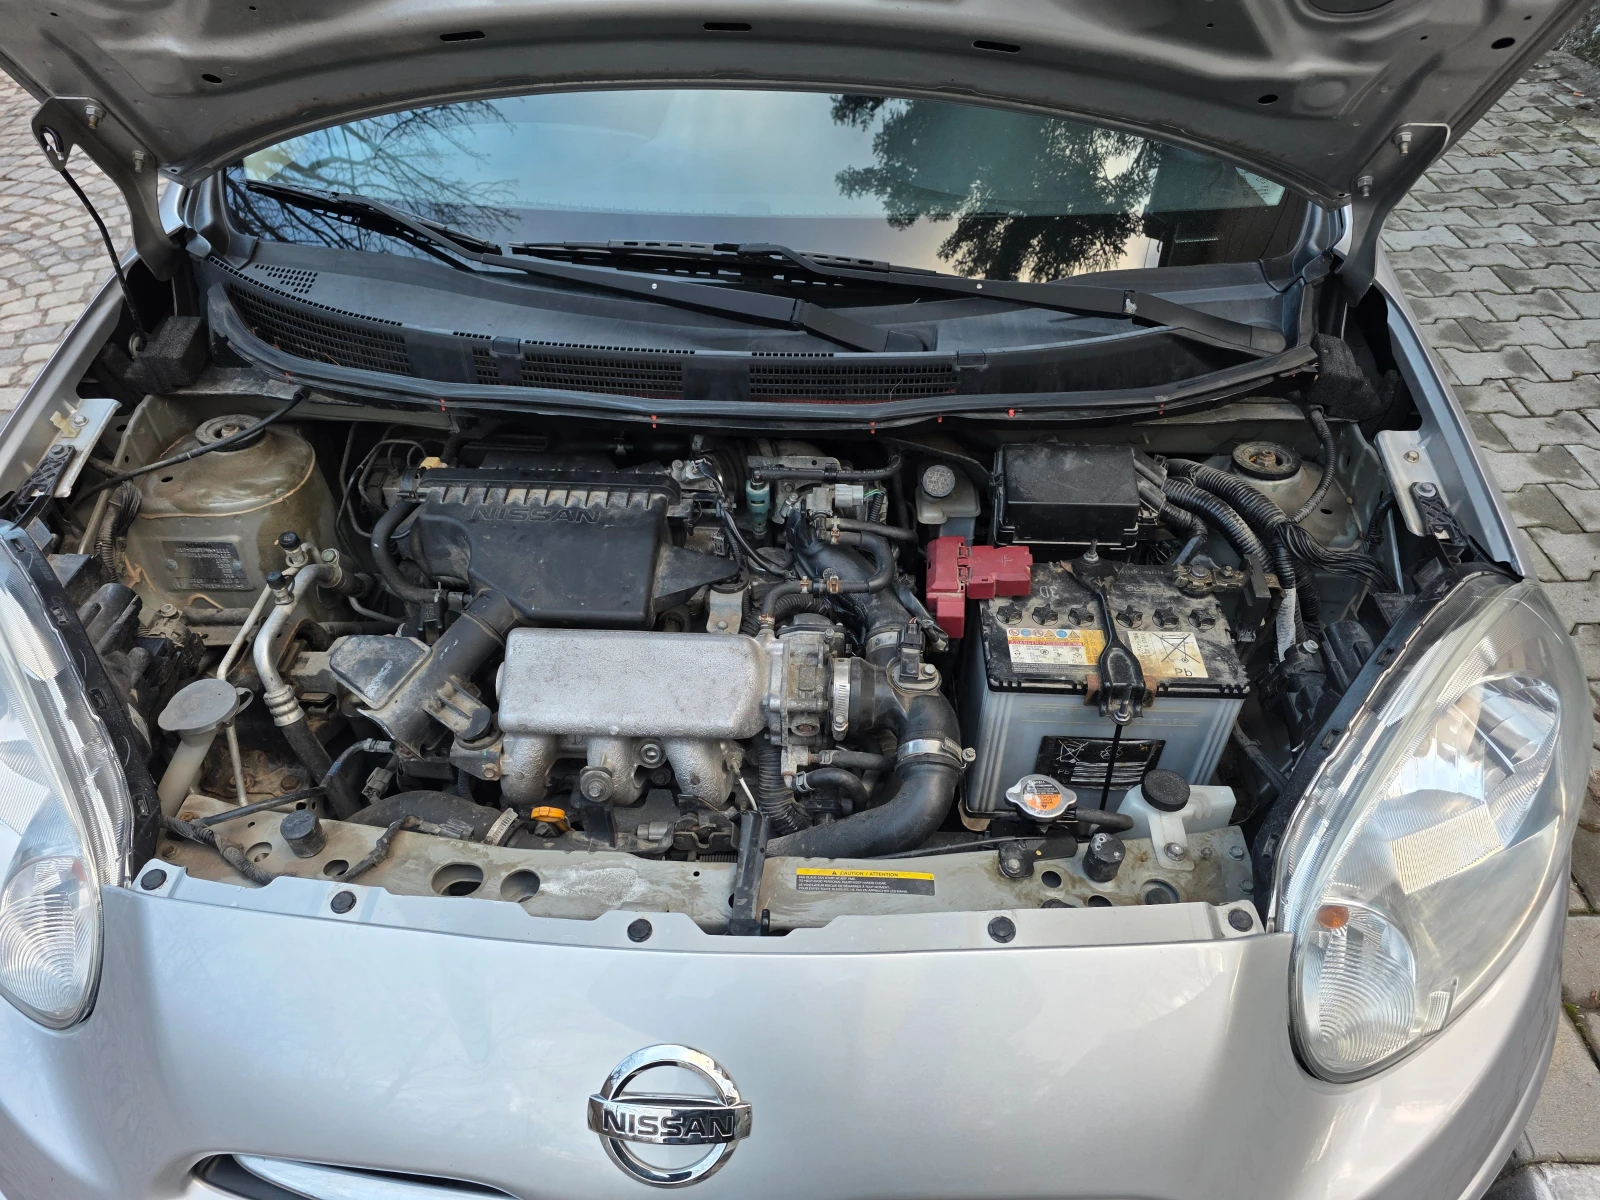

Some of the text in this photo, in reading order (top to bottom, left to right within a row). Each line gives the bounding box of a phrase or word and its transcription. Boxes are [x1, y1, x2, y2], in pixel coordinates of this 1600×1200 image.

[470, 506, 602, 523] NISSAN
[1174, 667, 1193, 677] Pb
[602, 1109, 734, 1138] NISSAN
